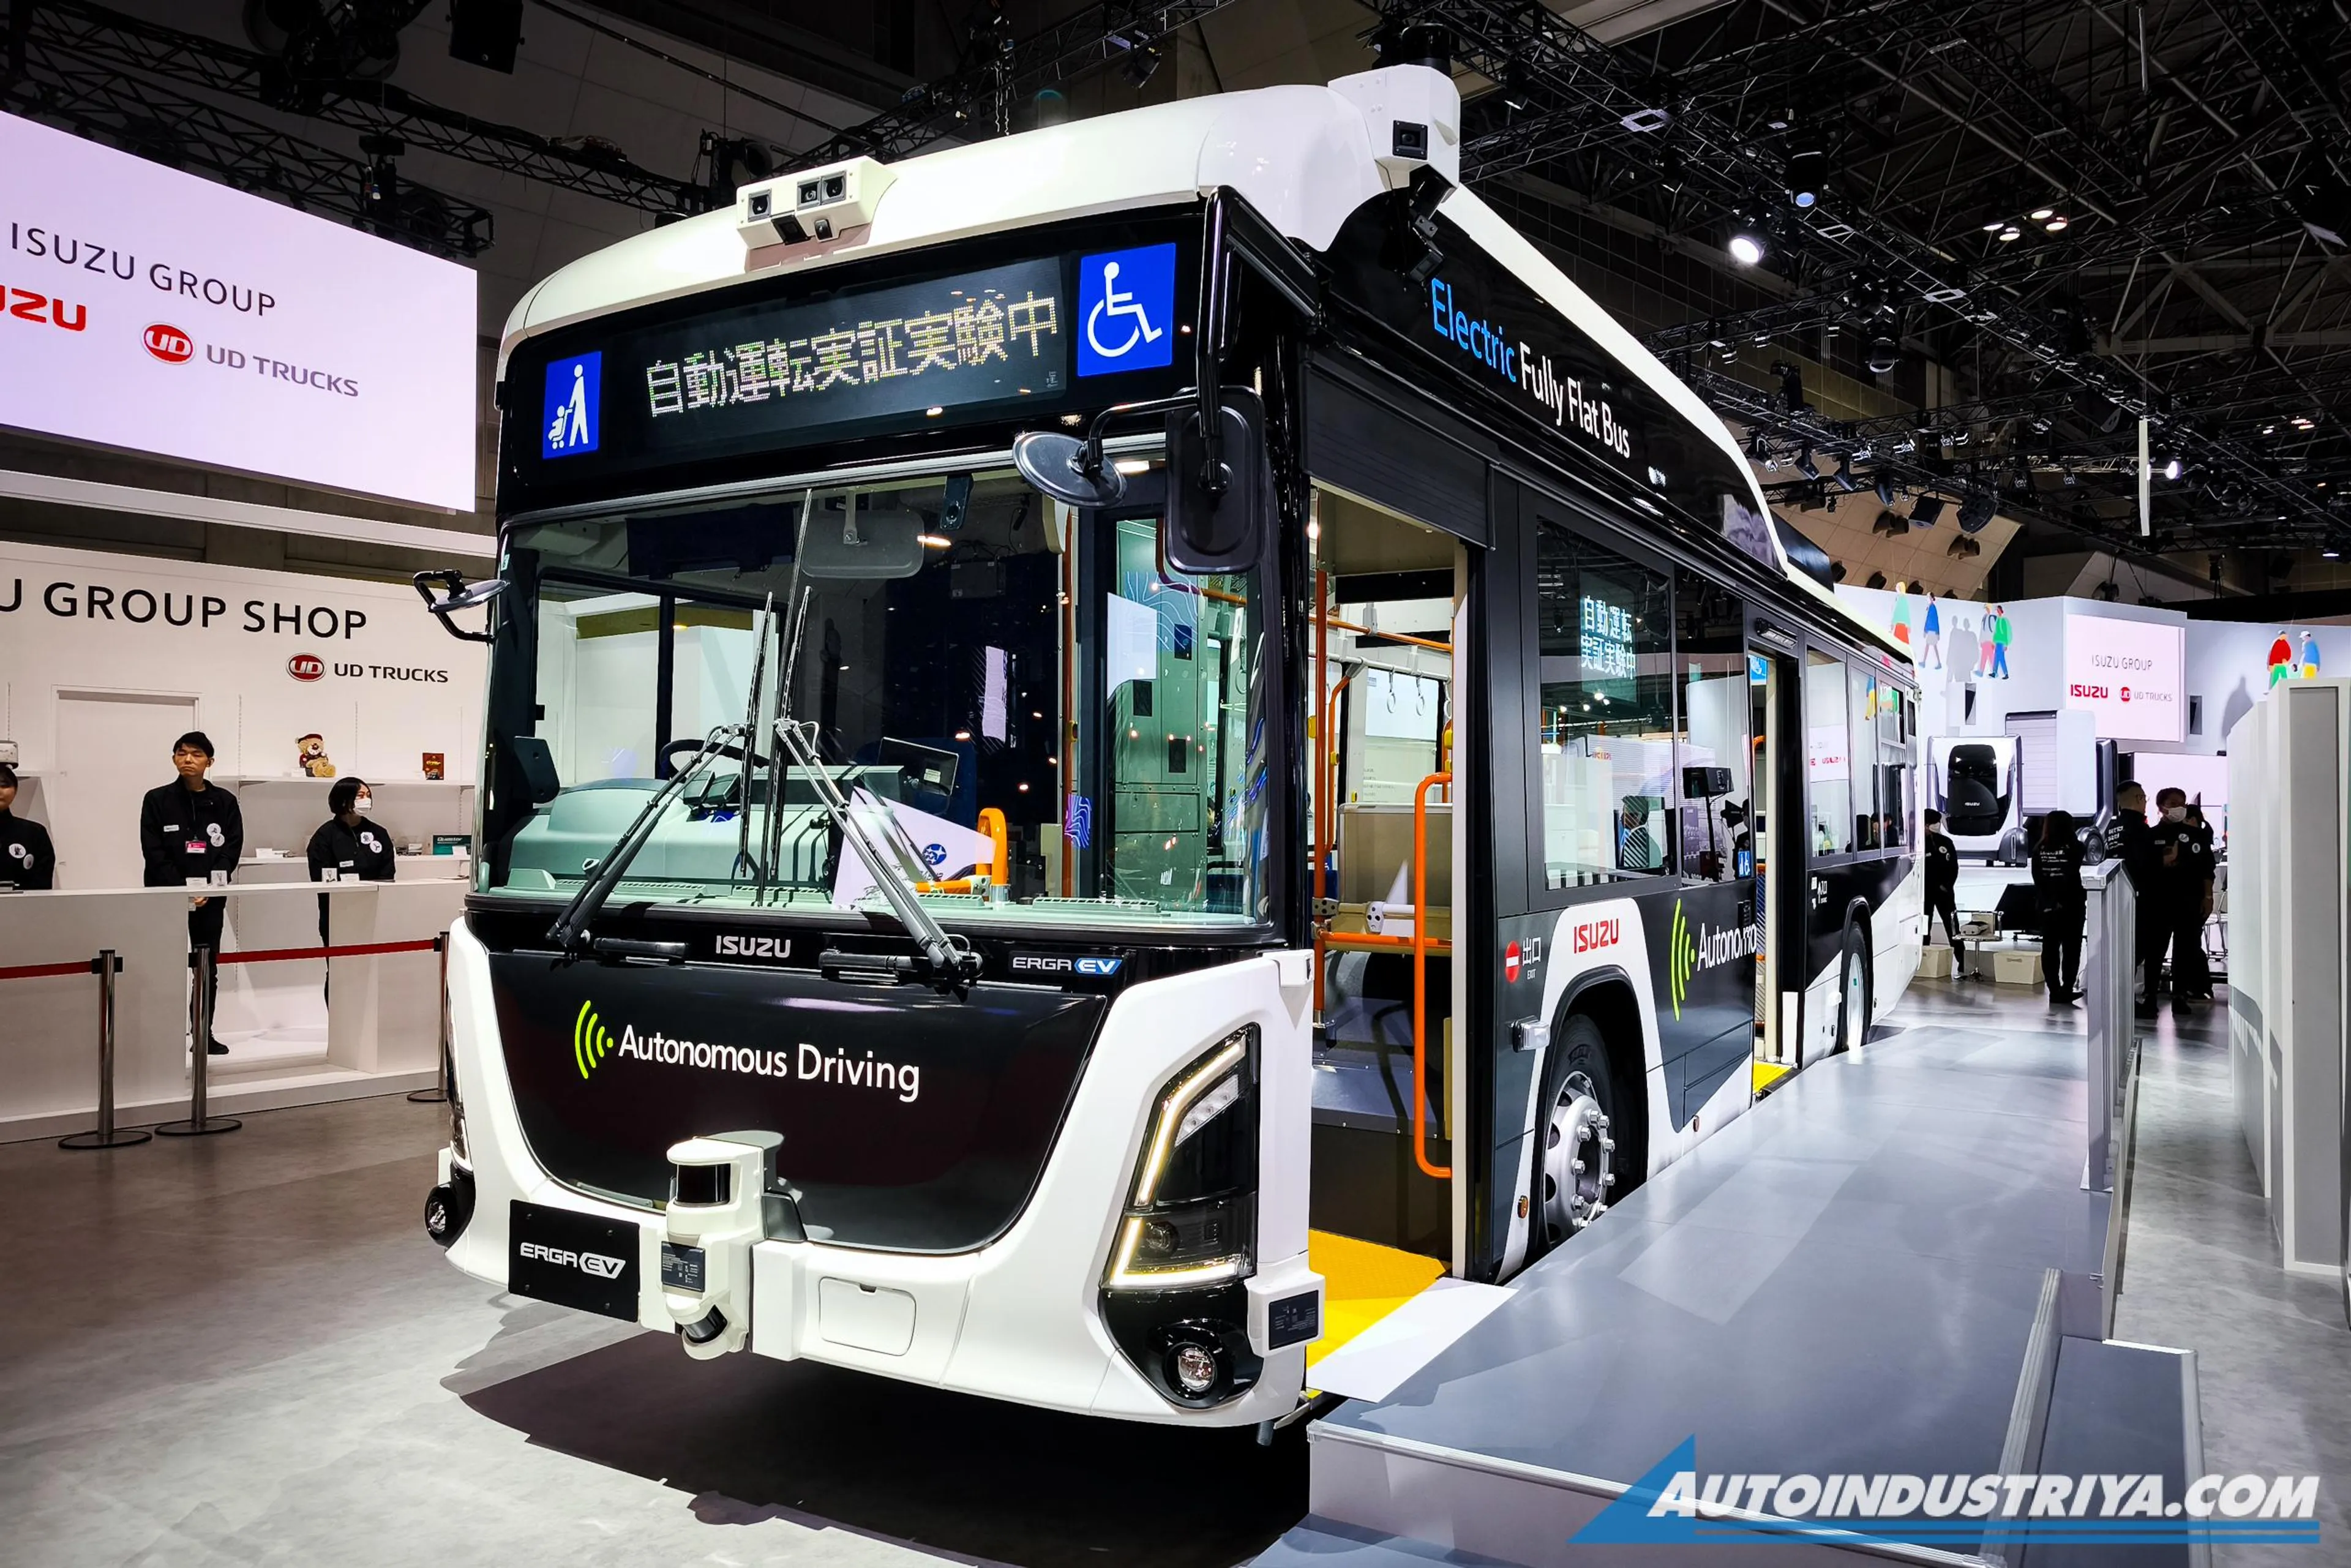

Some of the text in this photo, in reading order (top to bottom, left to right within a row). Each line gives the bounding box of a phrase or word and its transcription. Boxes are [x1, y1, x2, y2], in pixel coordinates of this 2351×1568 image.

[12, 222, 276, 317] ISUZU GROUP
[144, 329, 192, 357] UD
[647, 291, 1057, 417] 自動運転実証実験中
[207, 344, 359, 398] UD TRUCKS
[1431, 277, 1630, 459] Electric Fully Flat Bus
[43, 582, 226, 628] GROUP
[242, 599, 367, 639] SHOP
[1583, 595, 1633, 644] 自動運転
[289, 659, 324, 675] UD
[1580, 632, 1637, 680] 実証実験中
[2091, 655, 2153, 671] ISUZU GROUP
[334, 662, 449, 684] UD TRUCKS
[2071, 684, 2109, 699] ISUZU
[2146, 692, 2173, 702] TRUCKS
[715, 935, 791, 958] ISUZU
[1522, 937, 1541, 966] 出口
[1573, 918, 1619, 954] ISUZU
[1012, 957, 1116, 973] ERGA EV
[1527, 969, 1536, 980] EXIT
[618, 1024, 920, 1102] Autonomous Driving
[520, 1242, 626, 1279] ERGA EV
